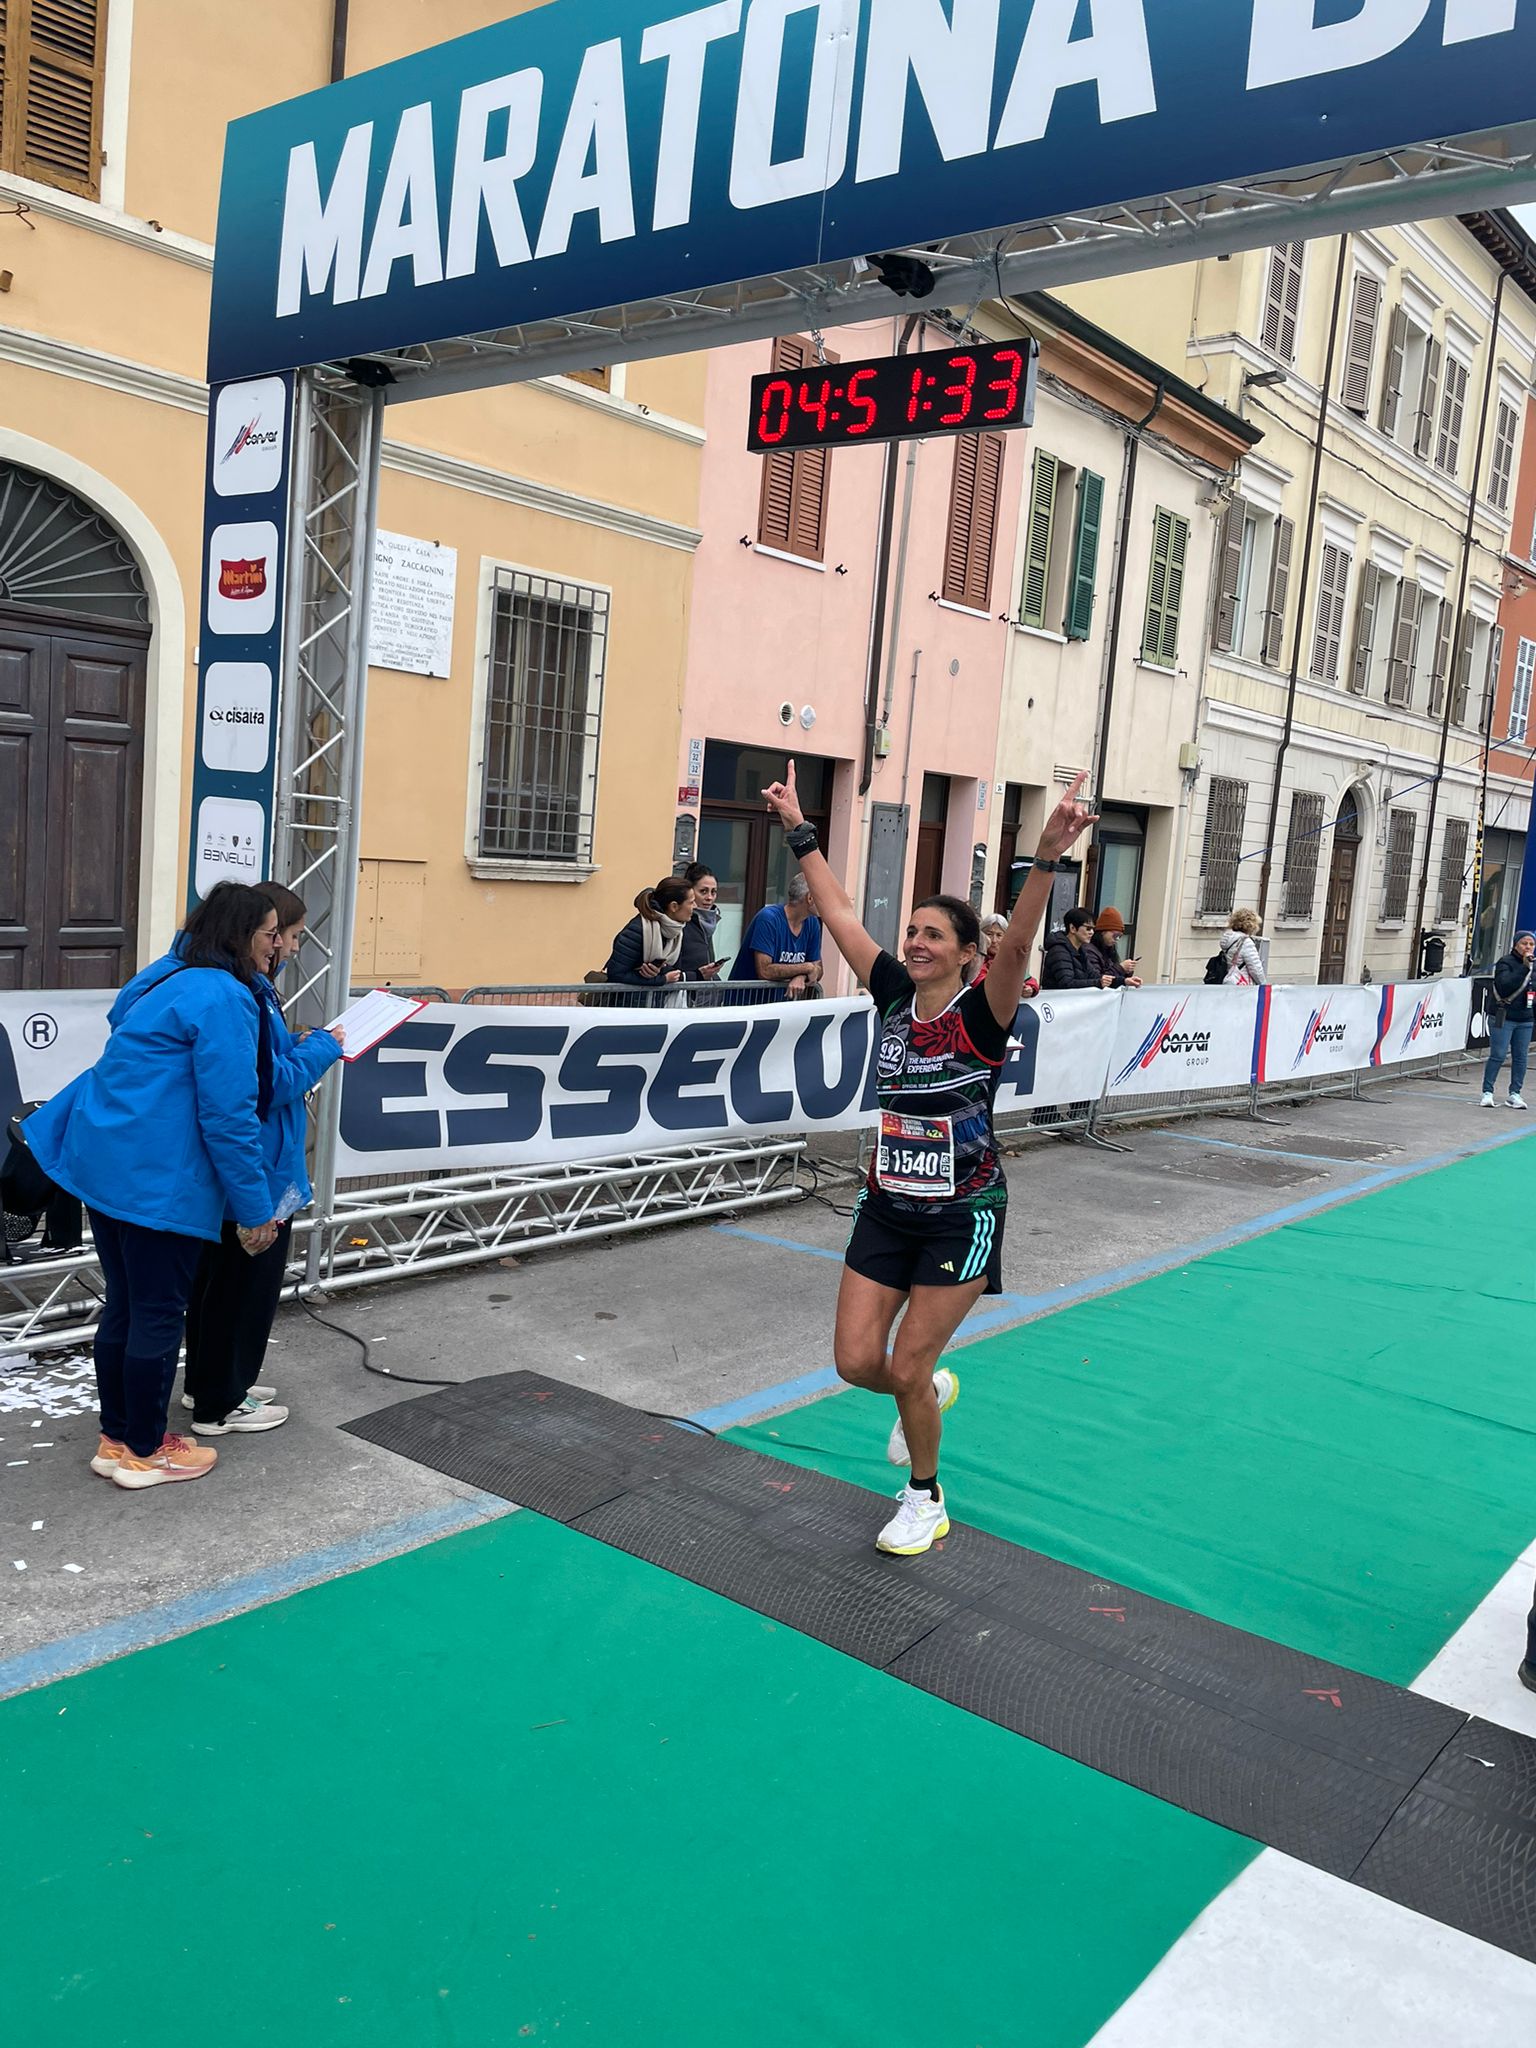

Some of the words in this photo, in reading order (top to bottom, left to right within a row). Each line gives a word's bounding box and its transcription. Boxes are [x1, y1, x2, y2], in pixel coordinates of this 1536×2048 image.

[277, 0, 1157, 318] MARATONA
[375, 553, 394, 565] IGNO
[401, 559, 444, 577] ZACCAGNINI
[226, 710, 264, 725] cisalfa
[906, 1062, 944, 1074] EXPERIENCE
[1186, 1057, 1209, 1066] GROUP
[340, 1003, 1040, 1152] ESSELUA
[892, 1149, 938, 1176] 1540
